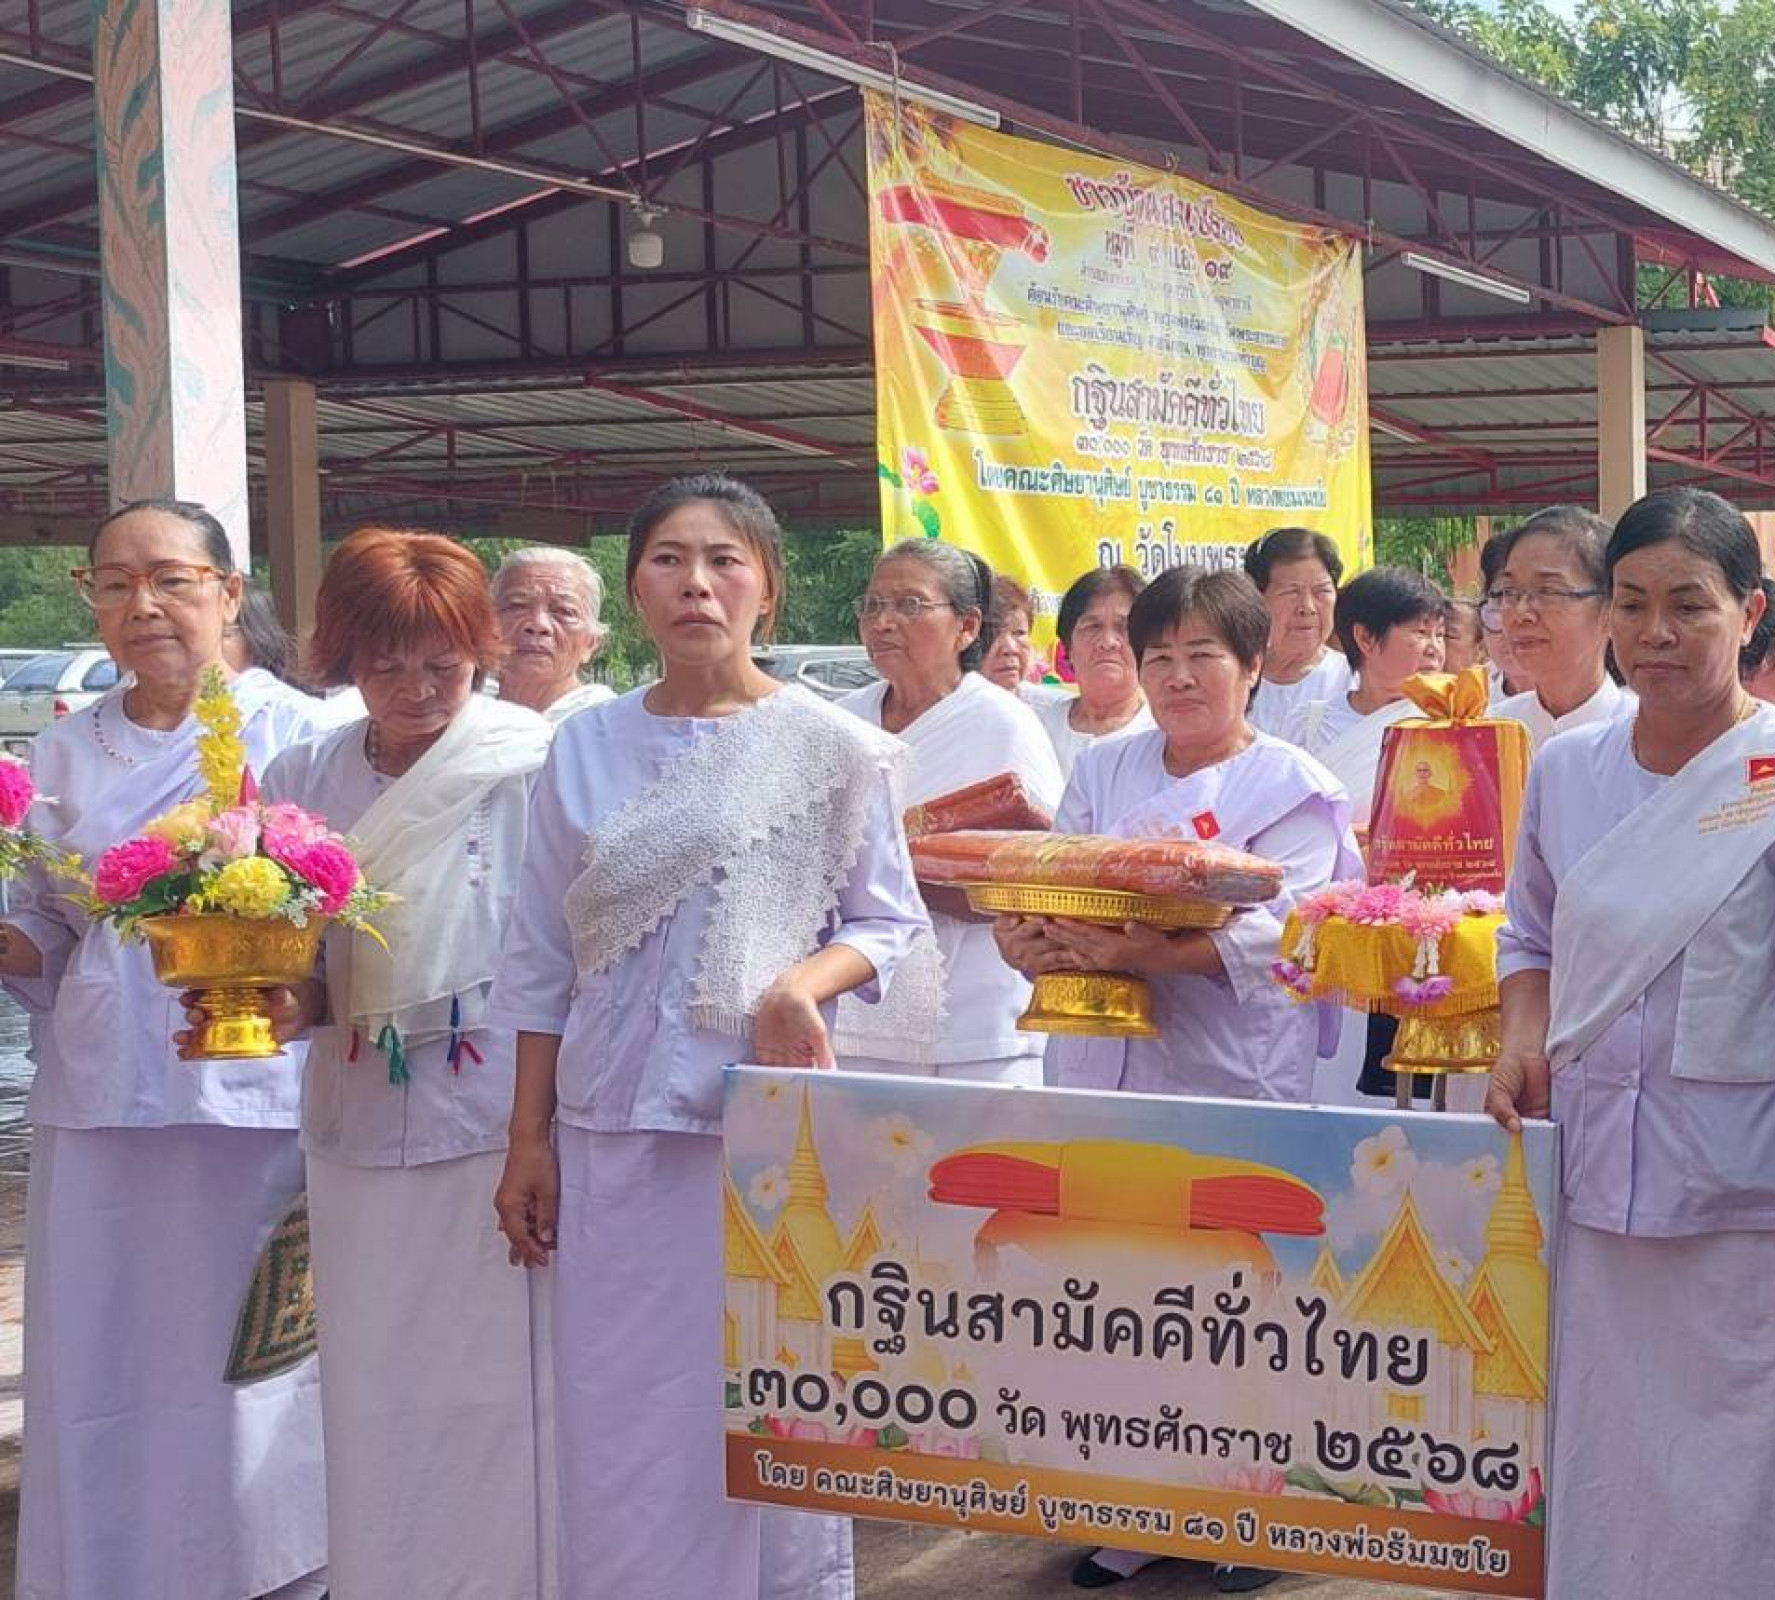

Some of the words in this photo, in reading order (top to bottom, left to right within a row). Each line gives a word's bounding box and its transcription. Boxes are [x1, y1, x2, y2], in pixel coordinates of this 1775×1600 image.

[1072, 362, 1265, 433] กฐินสามัคคีทั่วไทย
[1229, 476, 1241, 506] ปี
[827, 1260, 1429, 1386] กฐินสามัคคีทั่วไทย
[748, 1367, 978, 1430] ๓๐,๐๐๐
[996, 1387, 1046, 1438] วัด
[1062, 1404, 1293, 1465] พุทธศักราช
[1313, 1420, 1521, 1491] ๒๕๖๘
[757, 1453, 806, 1487] โดย
[815, 1471, 1027, 1519] คณะศิษยานุศิษย์
[1038, 1497, 1172, 1533] บูชาธรรม
[1184, 1516, 1224, 1542] ๘๑
[1236, 1512, 1256, 1544] ปี
[1269, 1522, 1510, 1575] หลวงพ่อธัมมชโย
